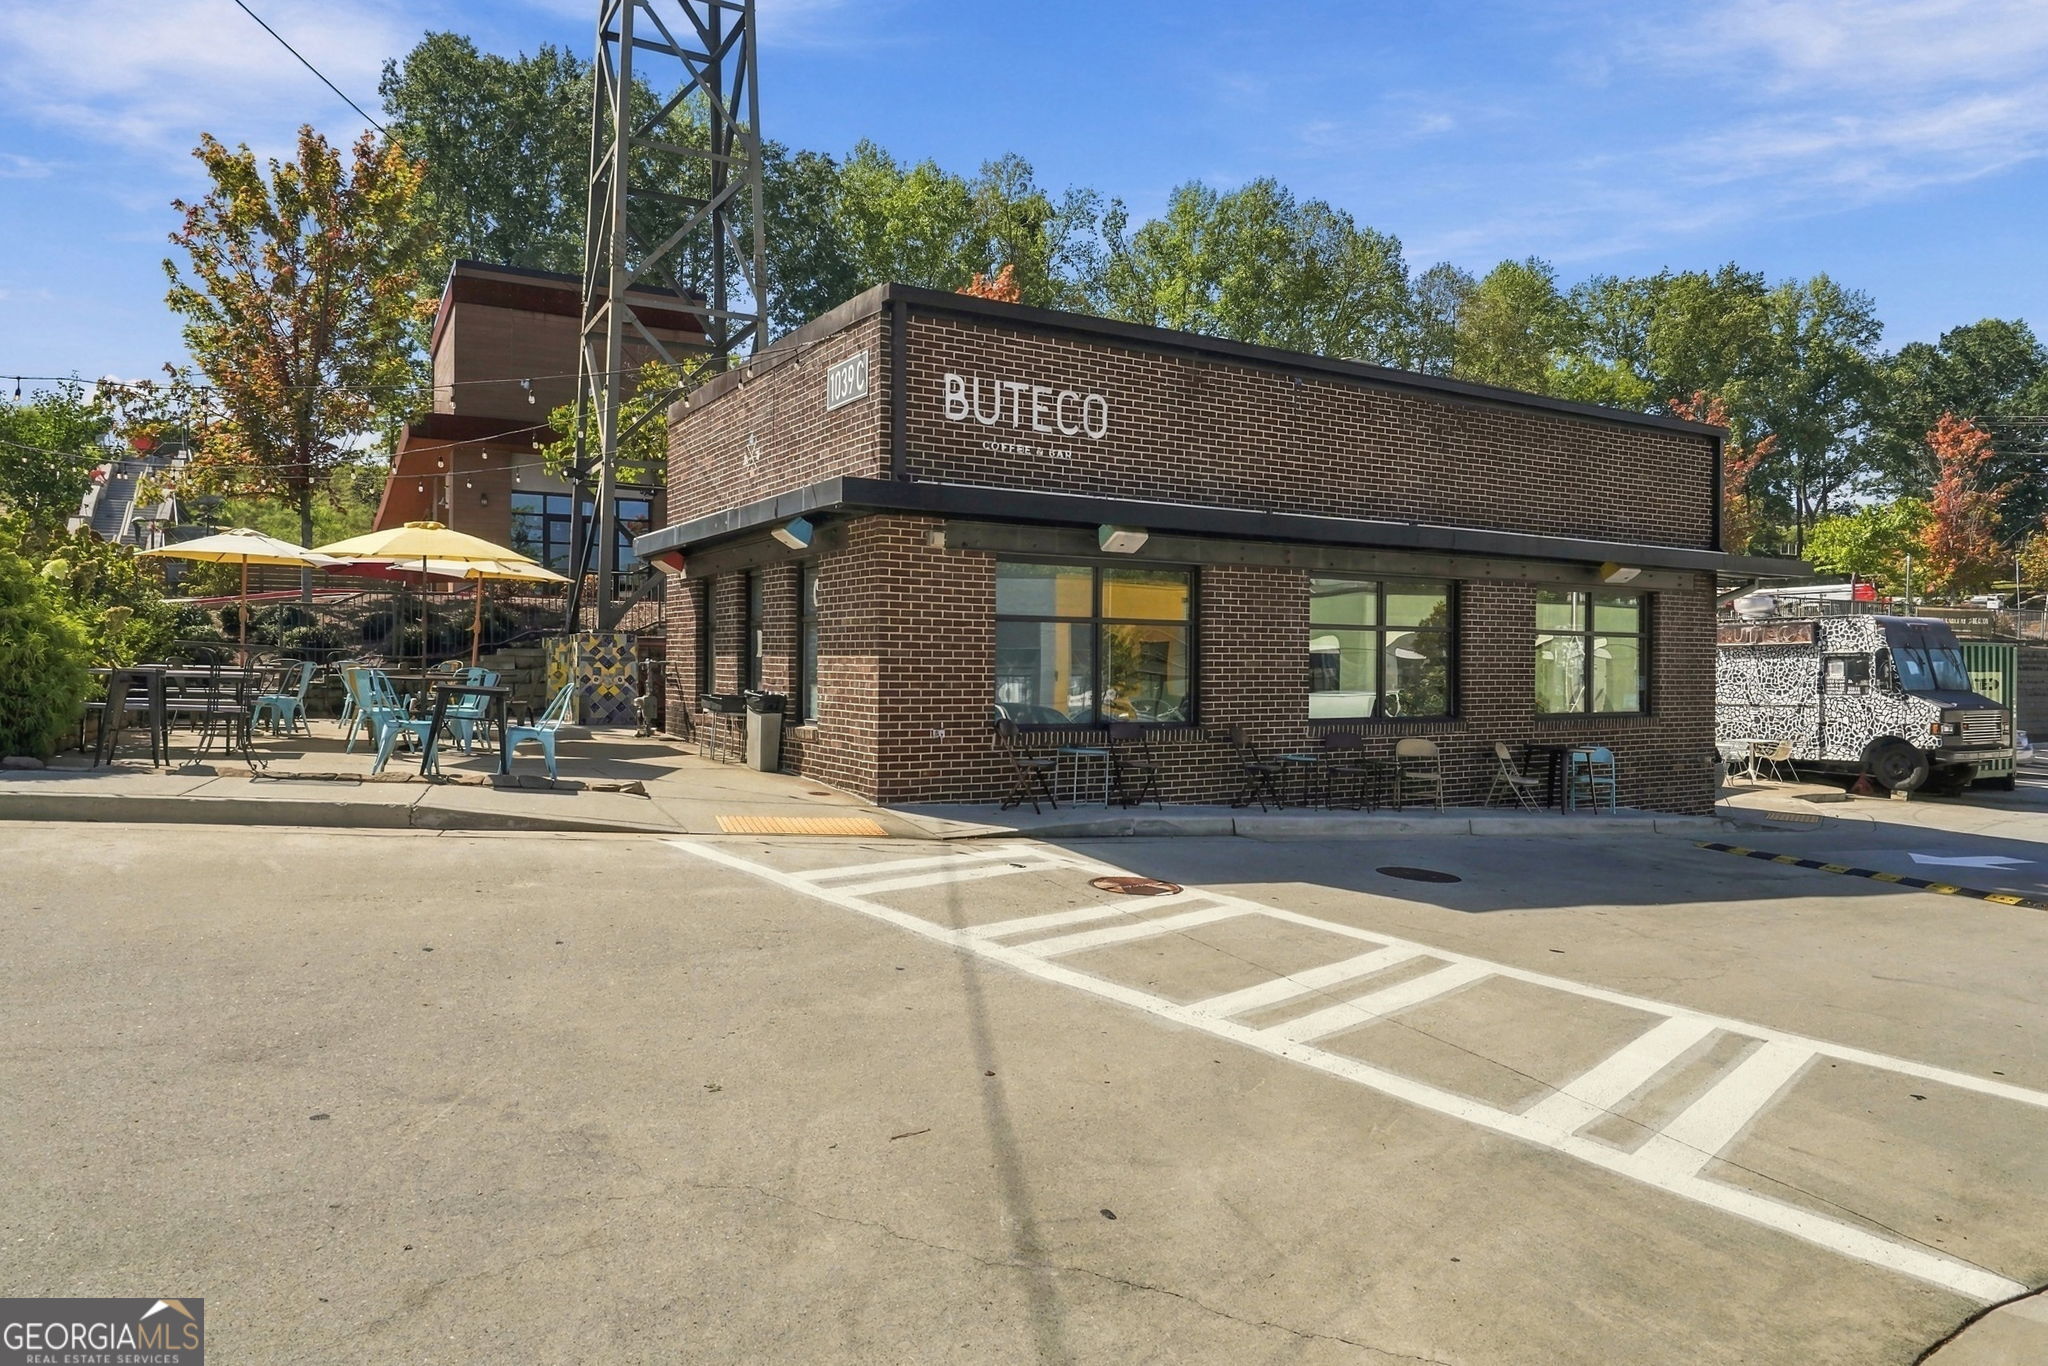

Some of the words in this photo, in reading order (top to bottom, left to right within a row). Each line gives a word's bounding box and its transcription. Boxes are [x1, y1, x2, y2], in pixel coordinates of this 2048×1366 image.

[830, 364, 855, 402] 1039
[856, 360, 865, 391] C
[944, 372, 1109, 440] BUTECO
[982, 440, 1032, 455] COFFEE
[1048, 449, 1072, 460] BAR
